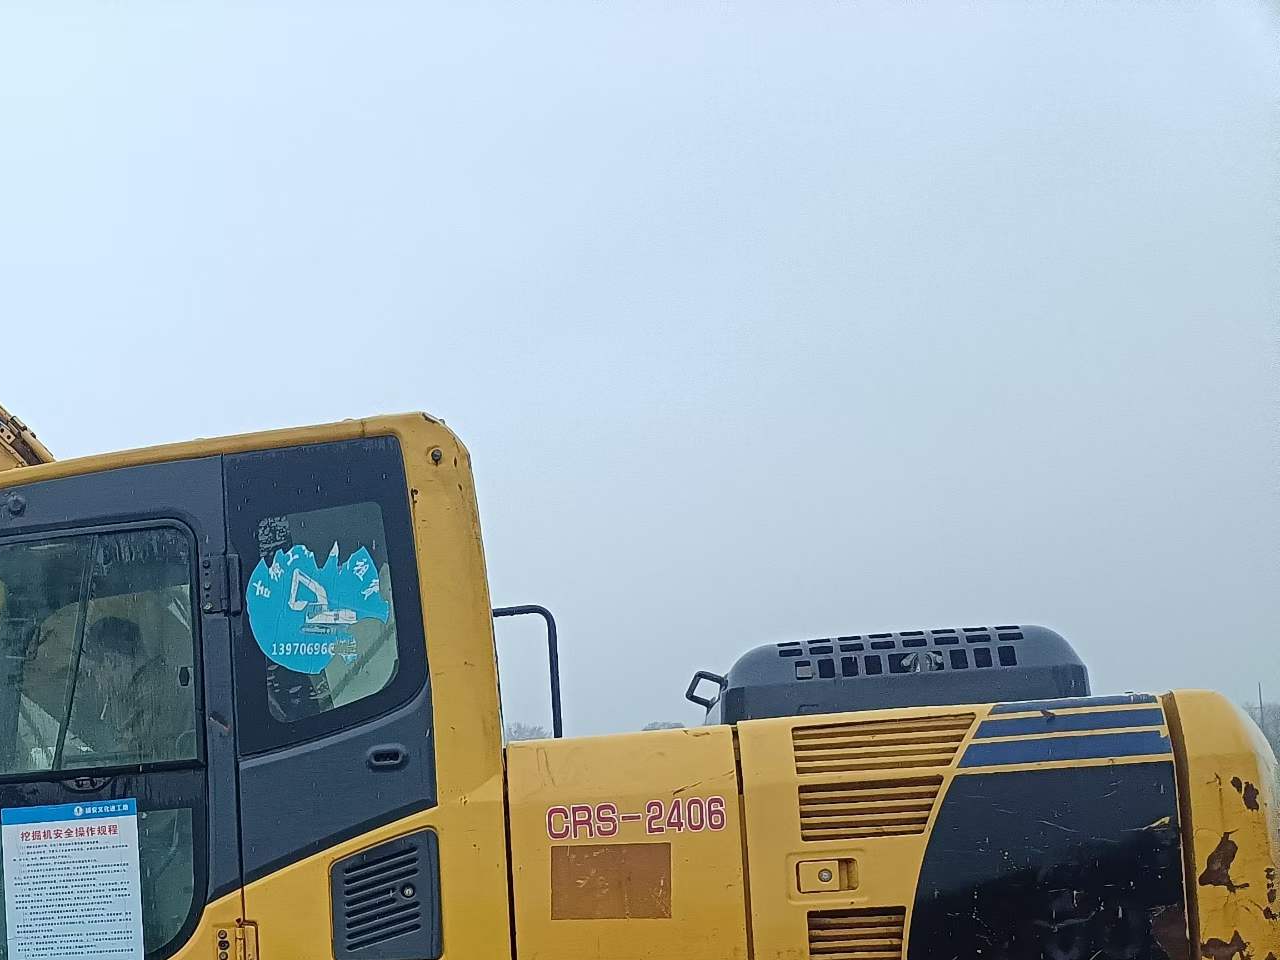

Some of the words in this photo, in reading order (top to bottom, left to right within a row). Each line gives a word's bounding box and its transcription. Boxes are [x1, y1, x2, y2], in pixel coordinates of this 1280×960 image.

[20, 824, 119, 842] 挖掘机安全操作规程
[547, 796, 726, 840] CRS-2406
